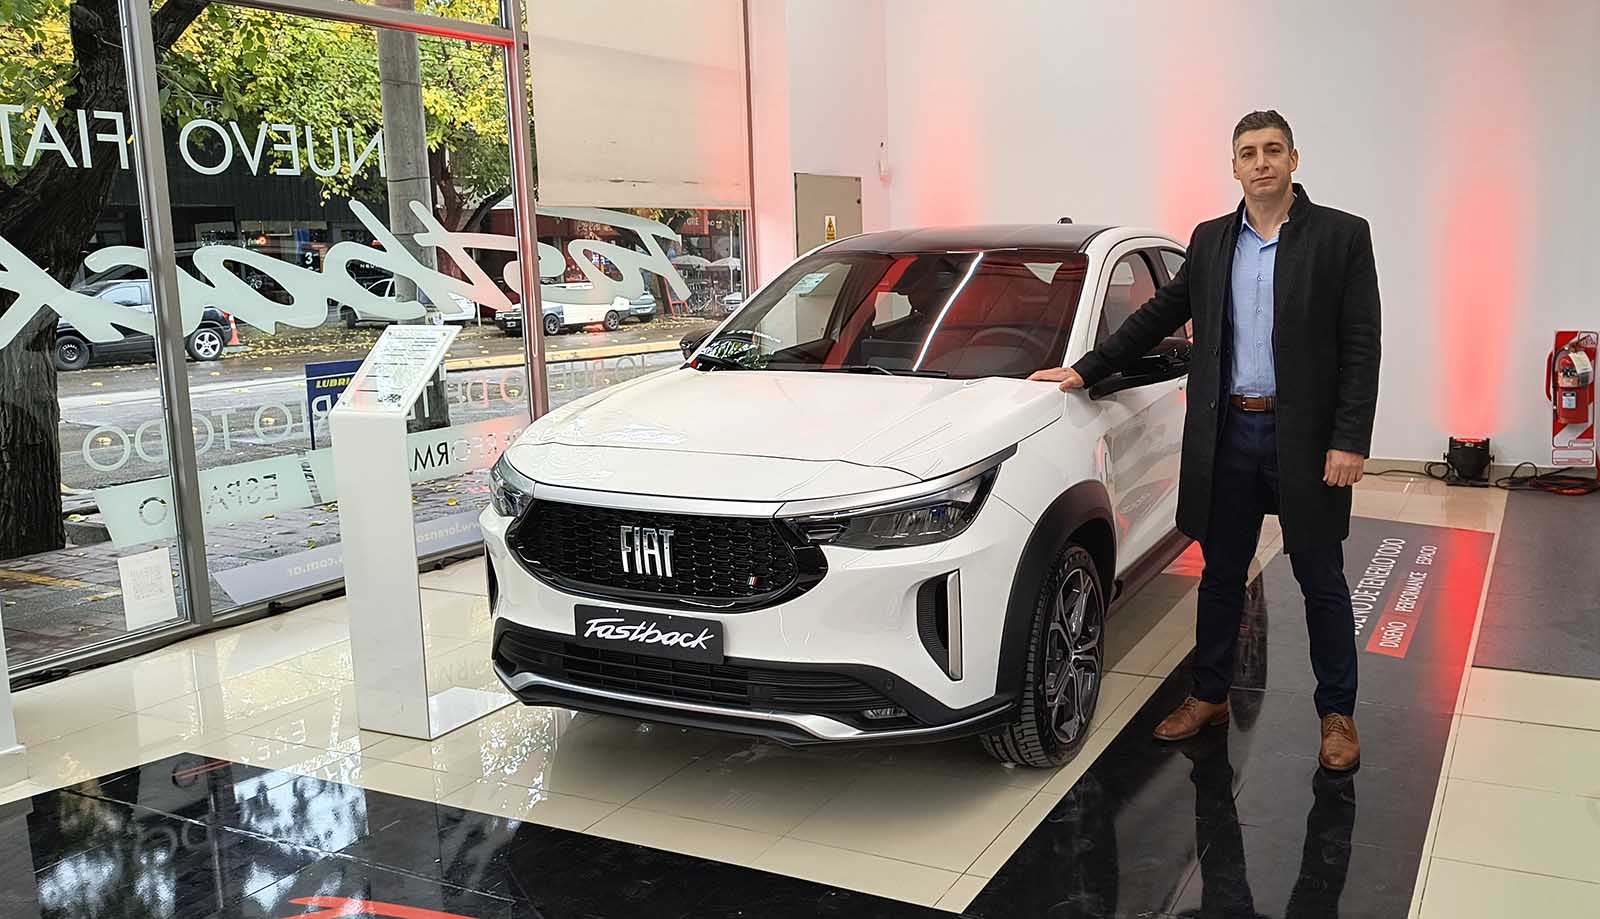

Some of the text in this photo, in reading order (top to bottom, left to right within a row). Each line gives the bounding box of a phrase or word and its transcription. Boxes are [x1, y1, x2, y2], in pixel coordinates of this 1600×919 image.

[315, 377, 350, 389] LUBRI
[620, 525, 674, 577] FIAT
[1374, 538, 1406, 558] TODO
[584, 617, 715, 649] Fastback
